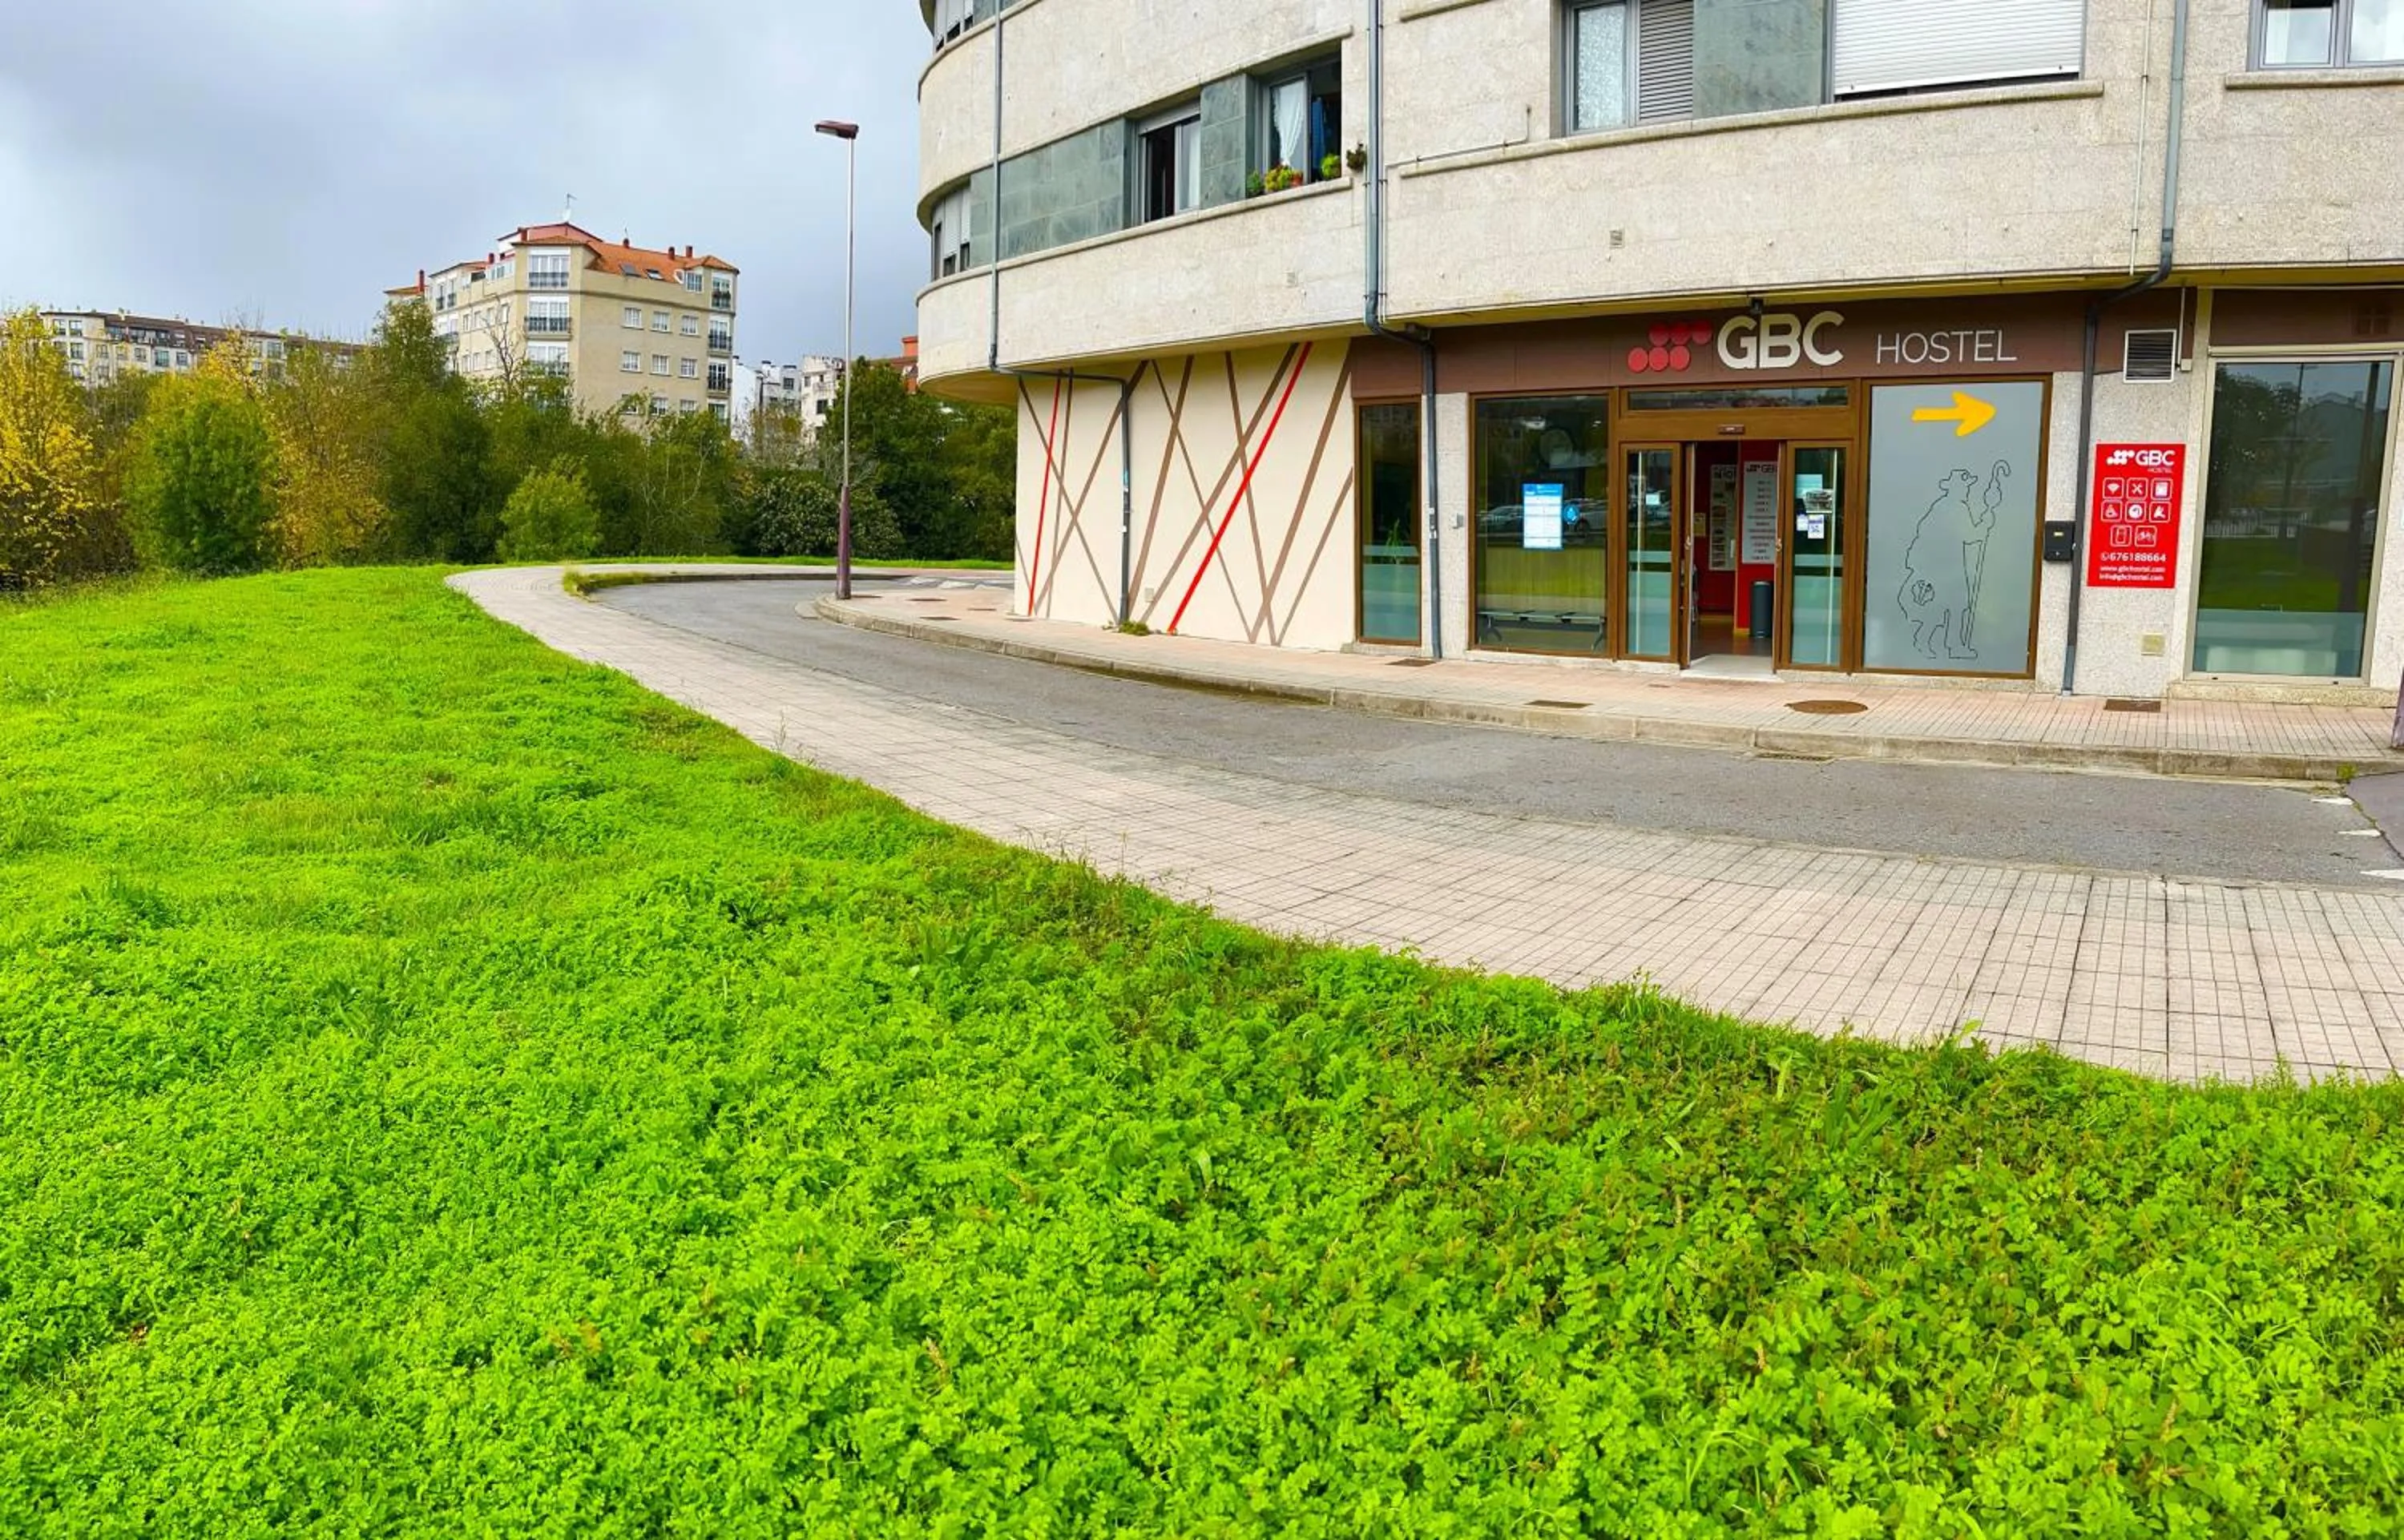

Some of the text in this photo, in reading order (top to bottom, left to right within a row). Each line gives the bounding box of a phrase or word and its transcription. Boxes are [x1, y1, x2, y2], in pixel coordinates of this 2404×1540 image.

[1717, 310, 2018, 370] GBC HOSTEL
[2135, 450, 2176, 466] GBC
